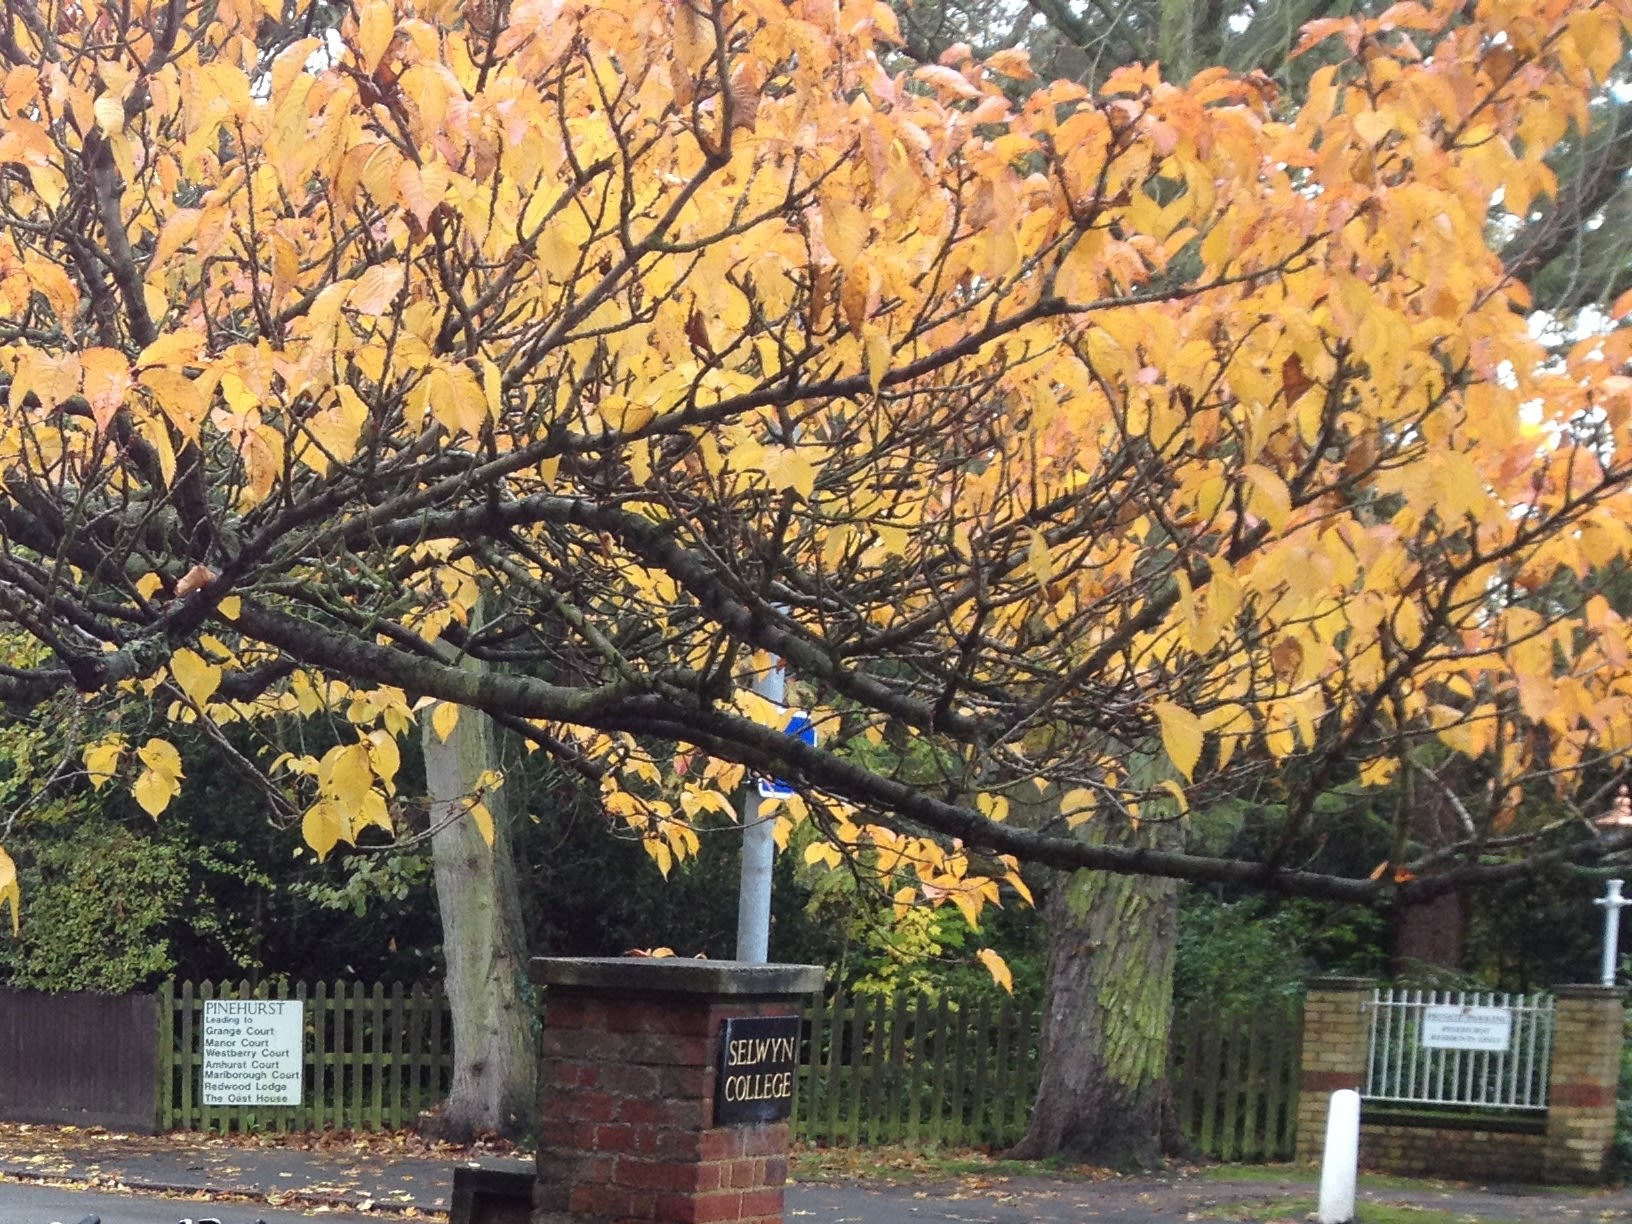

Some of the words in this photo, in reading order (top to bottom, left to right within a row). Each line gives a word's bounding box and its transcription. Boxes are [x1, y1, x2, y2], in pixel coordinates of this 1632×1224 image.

[206, 1002, 285, 1015] PINEHURST
[206, 1016, 240, 1025] Leading
[244, 1016, 253, 1024] to
[206, 1027, 242, 1036] Grange
[246, 1027, 274, 1036] Court
[205, 1039, 236, 1047] Manor
[241, 1039, 269, 1047] Court
[206, 1049, 257, 1058] Westberry
[261, 1049, 289, 1058] Court
[728, 1037, 795, 1066] SELWYN
[205, 1061, 247, 1069] Amhurst
[251, 1061, 279, 1069] Court
[204, 1071, 267, 1080] Marlborough
[272, 1071, 299, 1079] Court
[204, 1083, 251, 1091] Redwood
[256, 1083, 287, 1092] Lodge
[725, 1072, 792, 1102] COLLEGE
[206, 1094, 223, 1102] The
[228, 1094, 252, 1102] Oast
[256, 1094, 288, 1103] House
